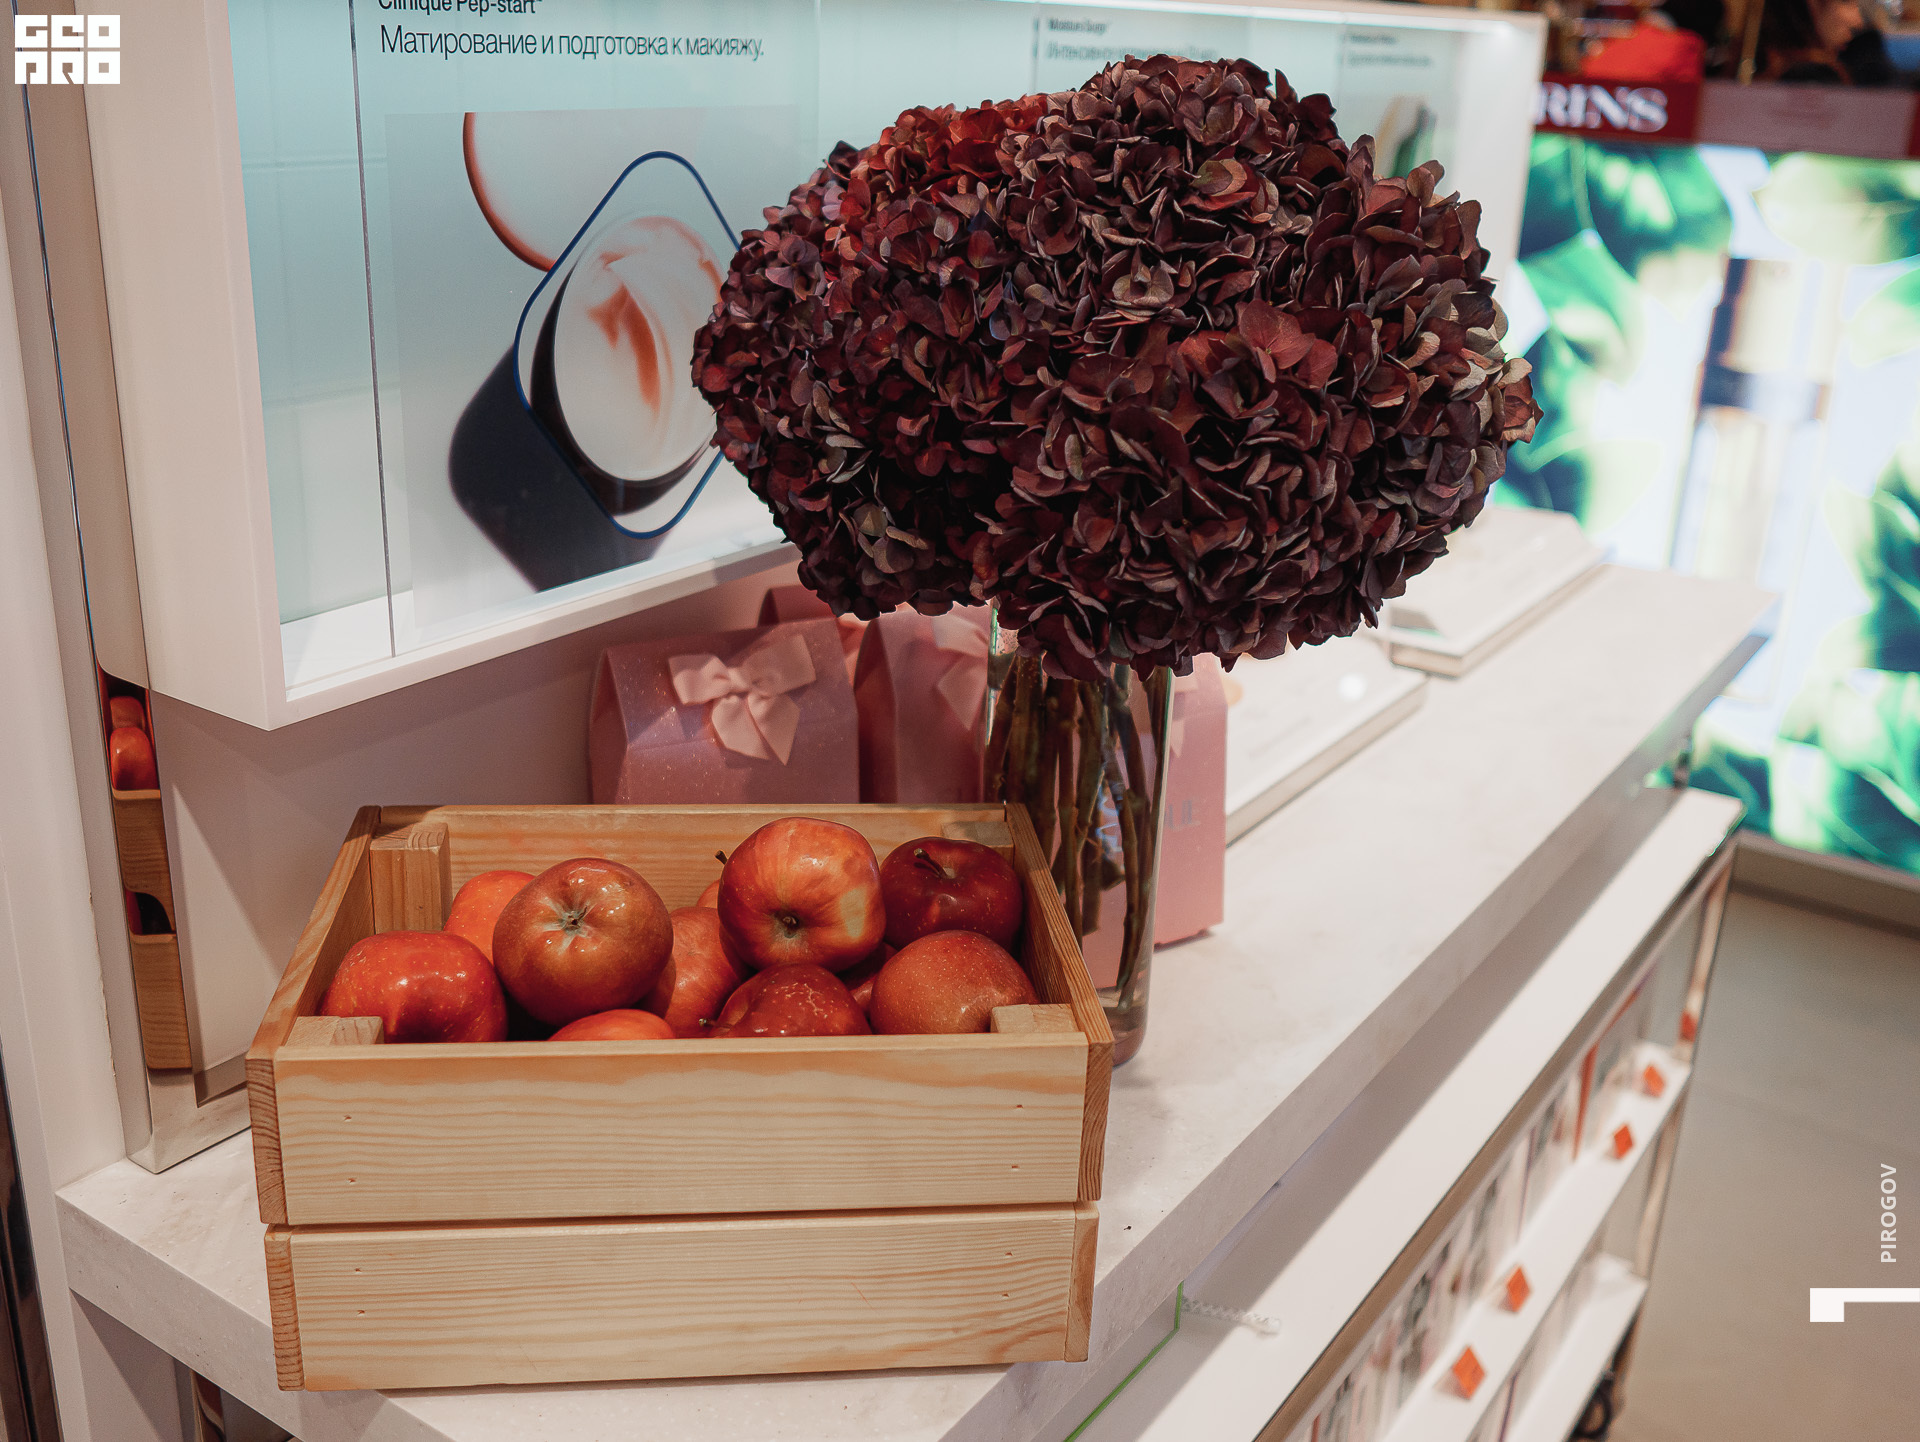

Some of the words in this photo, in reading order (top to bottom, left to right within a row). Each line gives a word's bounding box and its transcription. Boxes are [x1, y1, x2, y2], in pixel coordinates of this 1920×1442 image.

[380, 24, 537, 61] Матирование
[541, 34, 554, 54] и
[558, 34, 669, 60] подготовка
[672, 36, 683, 56] к
[686, 36, 765, 62] макияжу.
